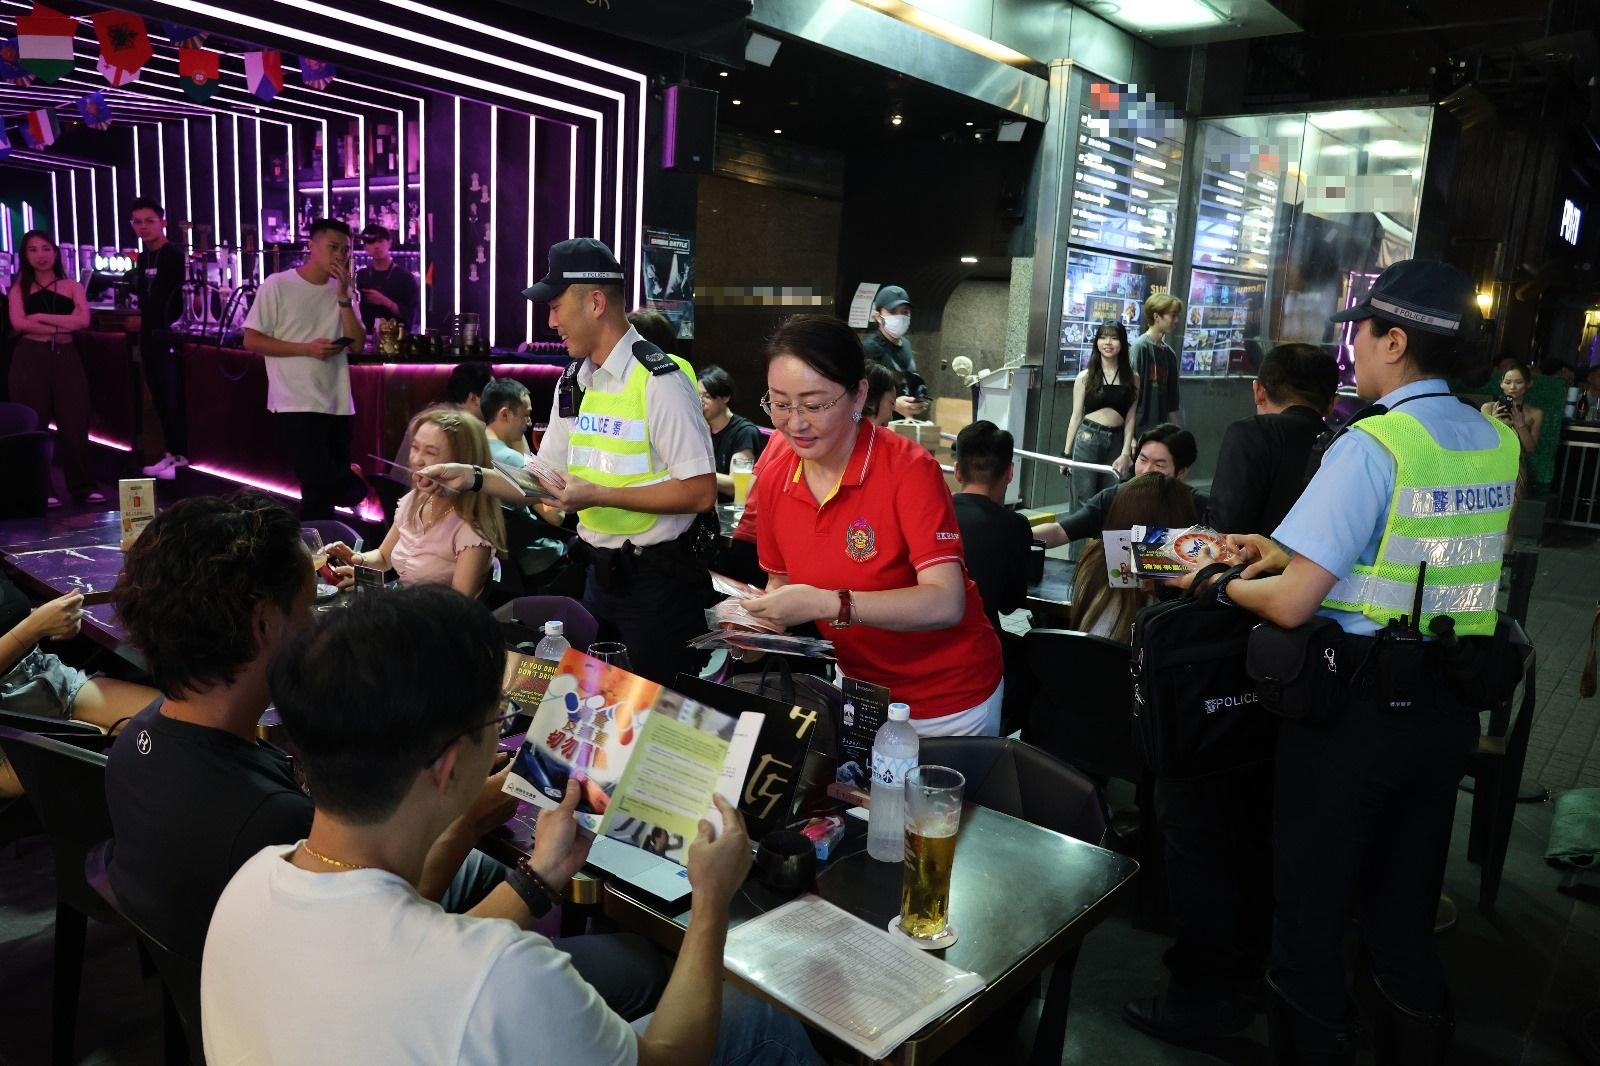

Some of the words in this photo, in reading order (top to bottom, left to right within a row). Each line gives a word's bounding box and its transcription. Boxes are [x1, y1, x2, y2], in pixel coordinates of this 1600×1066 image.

[1399, 309, 1426, 322] POLICE
[1432, 490, 1449, 512] 警
[1455, 486, 1504, 511] POLICE
[529, 662, 542, 671] YOU
[1216, 692, 1259, 709] POLICE
